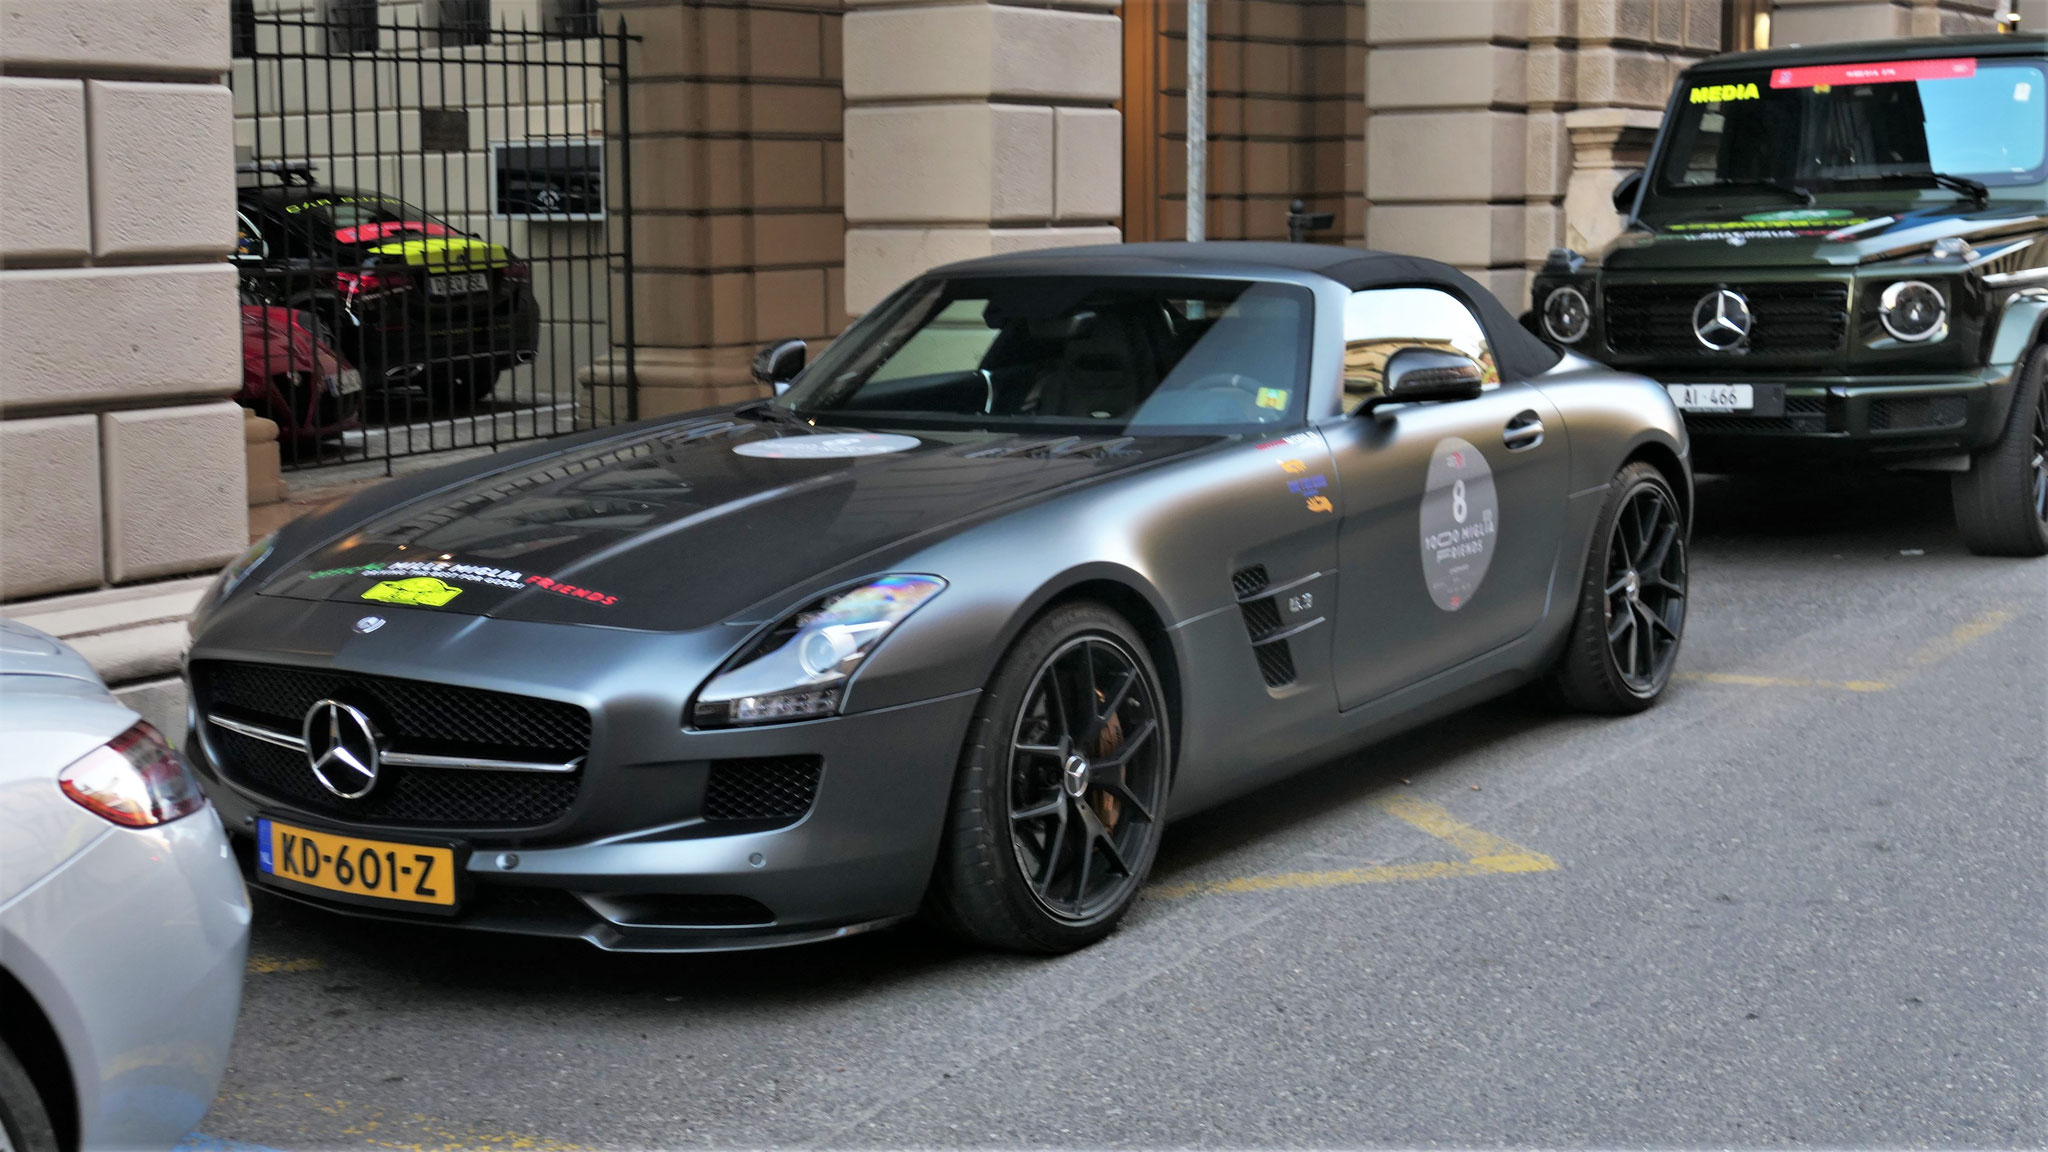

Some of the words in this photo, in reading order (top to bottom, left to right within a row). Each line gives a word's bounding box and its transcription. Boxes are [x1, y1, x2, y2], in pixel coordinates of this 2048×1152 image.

[1689, 83, 1760, 104] MEDIA
[1709, 387, 1737, 405] 466
[1452, 479, 1468, 524] 8
[387, 561, 451, 572] MILLE
[448, 563, 523, 581] MIGLIA
[524, 575, 619, 606] FRIENDS
[459, 572, 484, 583] FOR
[281, 832, 436, 897] KD-601-Z
